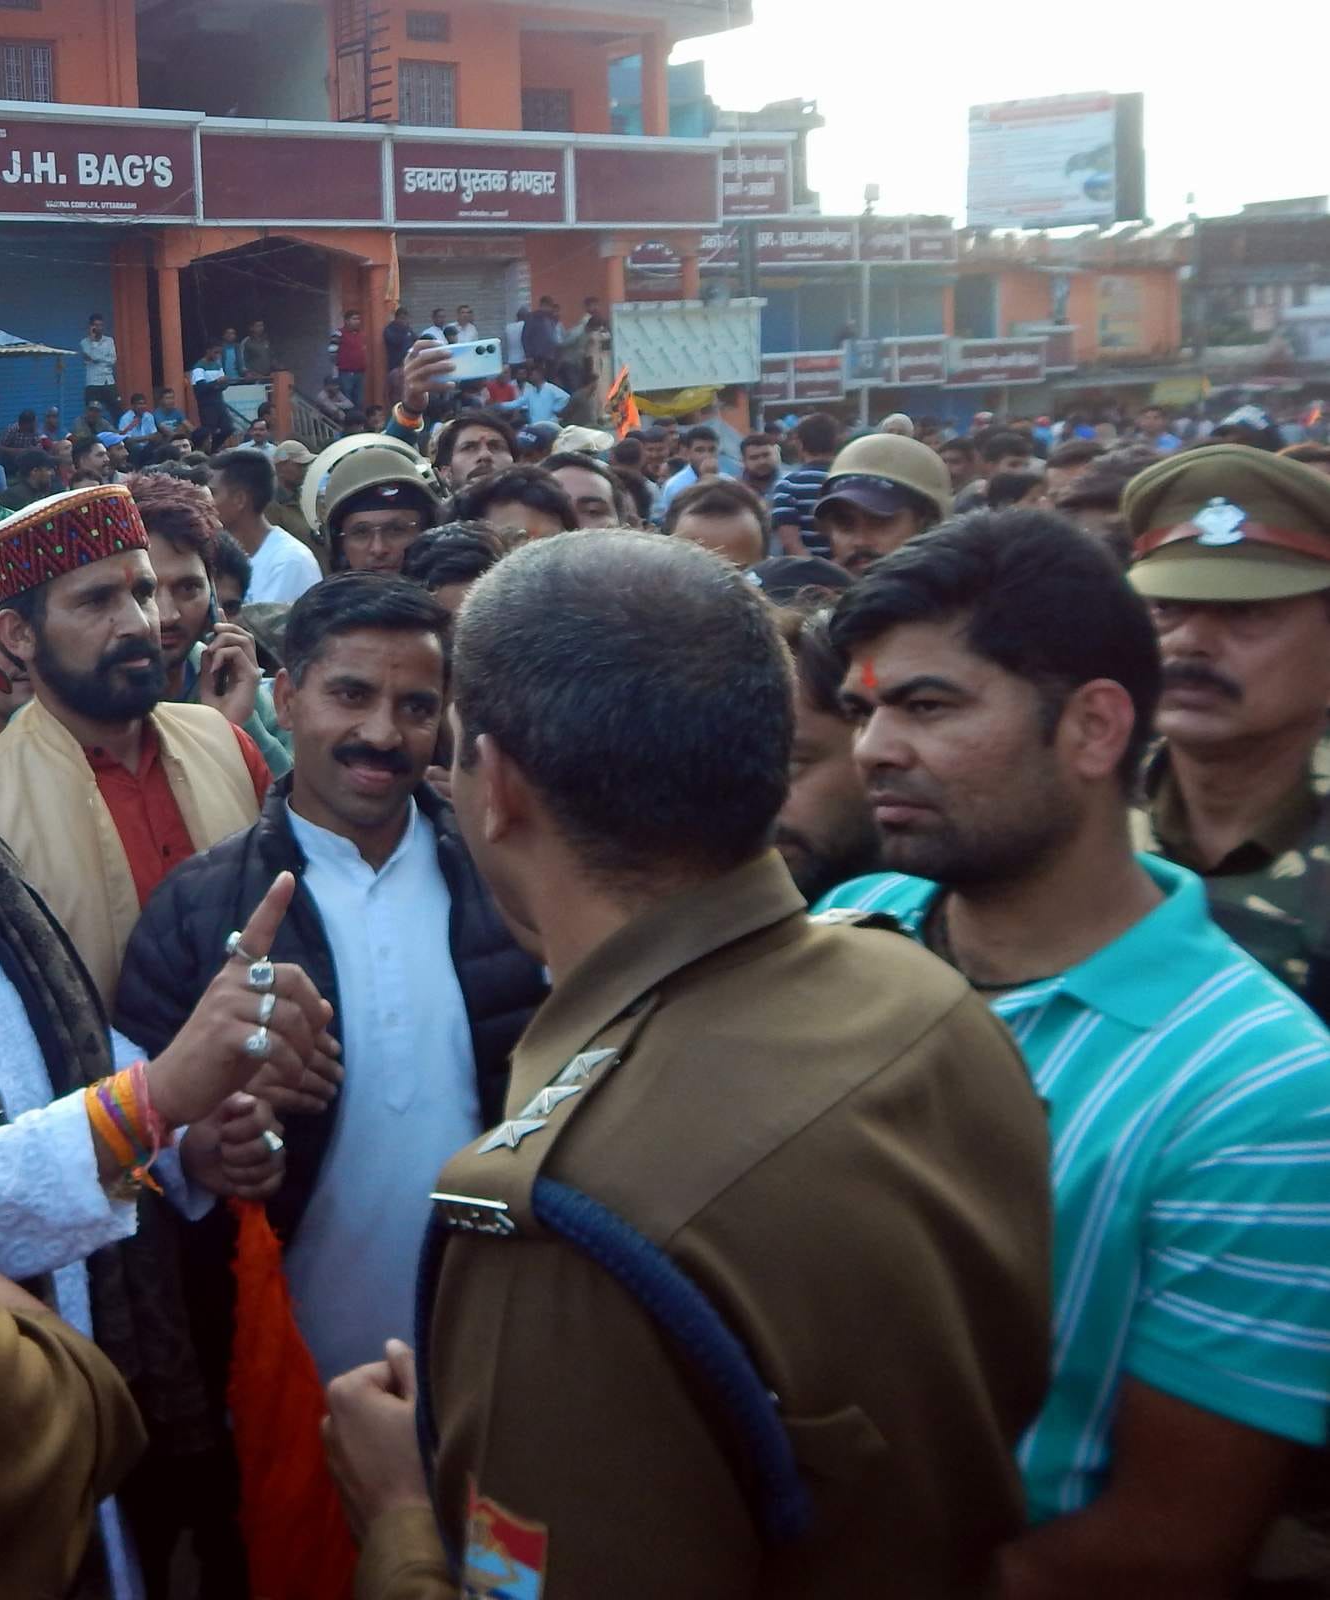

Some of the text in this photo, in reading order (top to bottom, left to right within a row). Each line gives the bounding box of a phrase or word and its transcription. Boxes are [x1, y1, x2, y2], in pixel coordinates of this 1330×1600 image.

[2, 151, 173, 187] J.H. BAG'S
[403, 167, 557, 203] डबराल पुस्तक भण्डार
